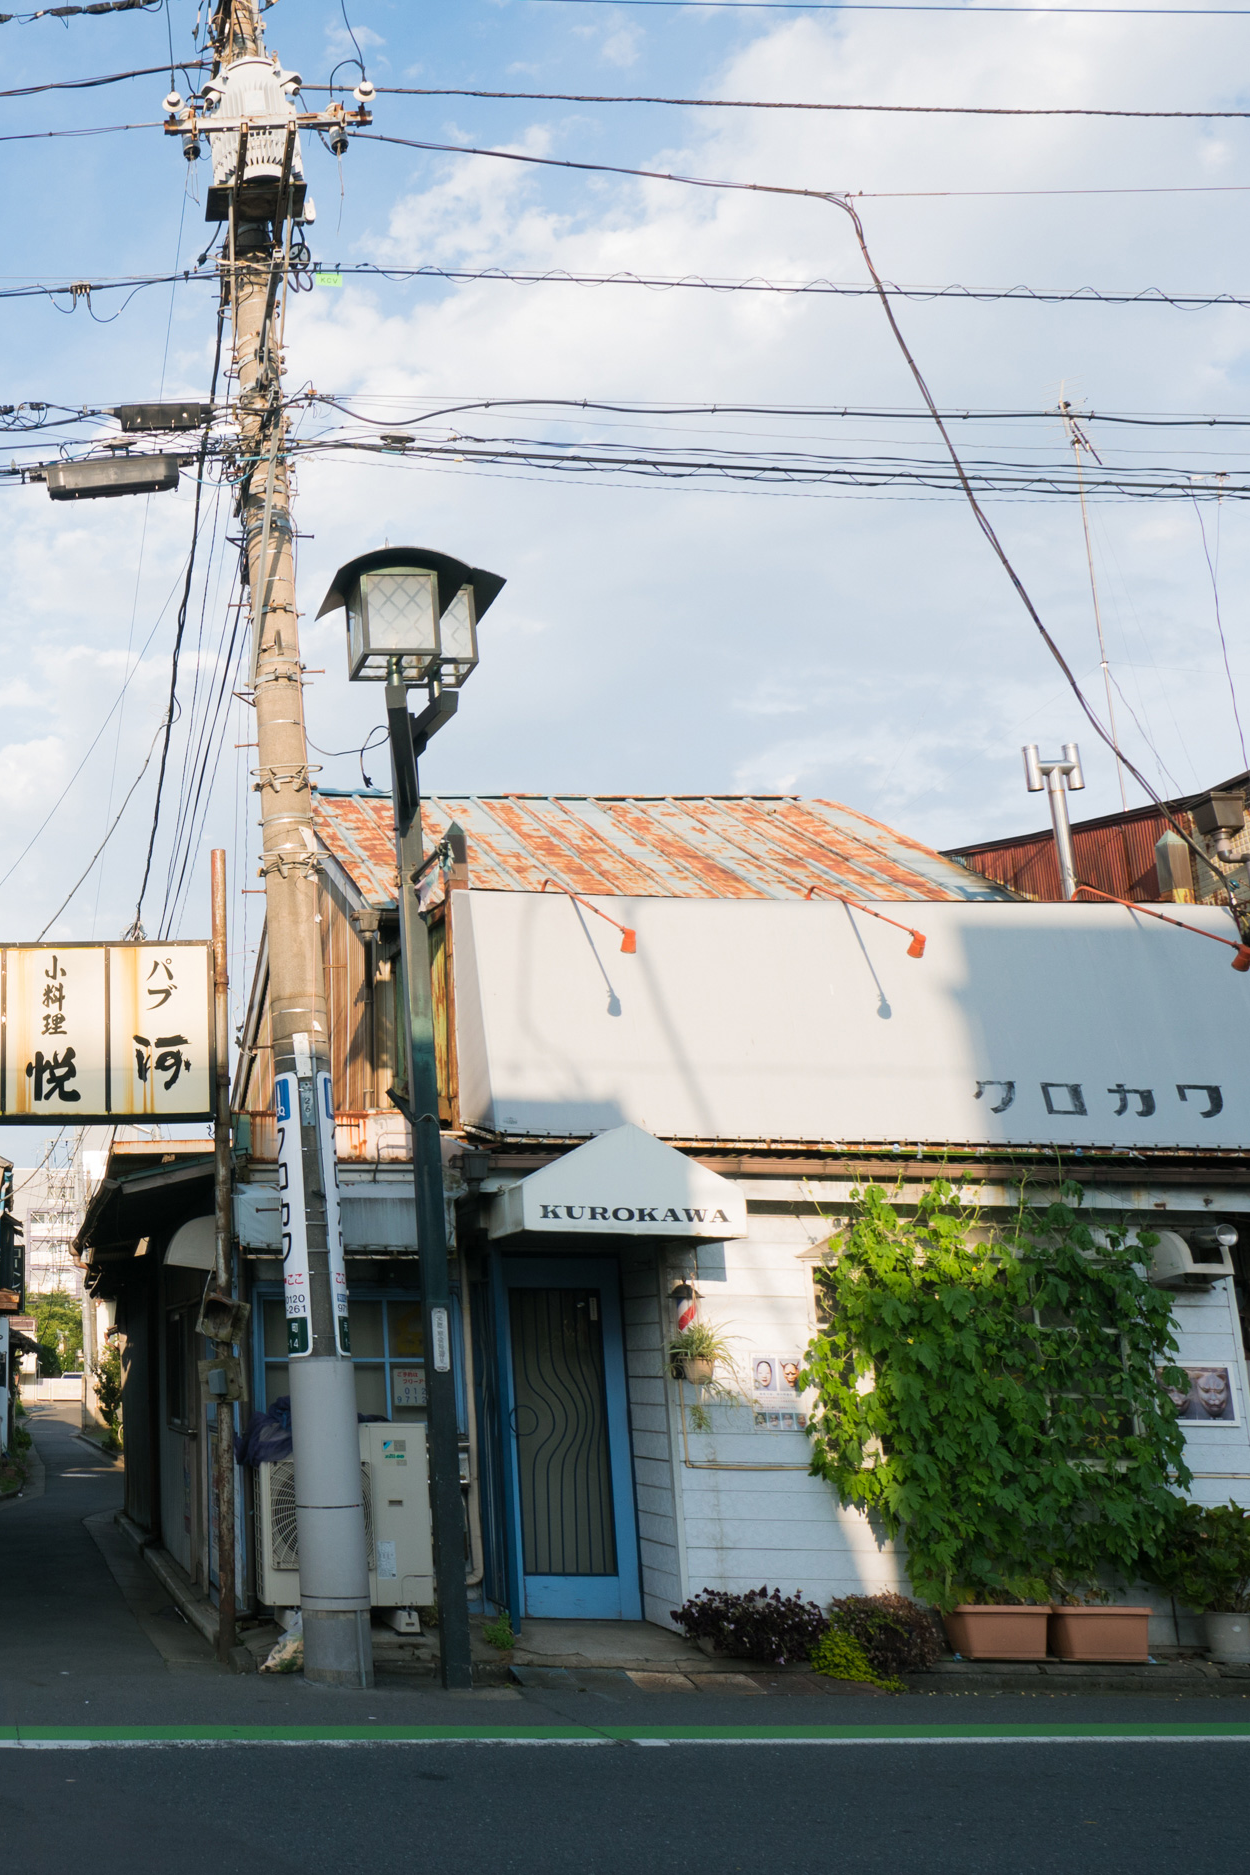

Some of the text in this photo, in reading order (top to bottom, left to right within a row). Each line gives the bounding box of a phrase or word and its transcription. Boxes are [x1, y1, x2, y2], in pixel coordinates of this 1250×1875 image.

[41, 955, 68, 1035] 小料理
[146, 958, 178, 1010] パブ
[26, 1046, 81, 1102] 悦
[973, 1080, 1224, 1119] クロカワ
[539, 1204, 732, 1223] KUROKAWA
[288, 1273, 303, 1286] ここ
